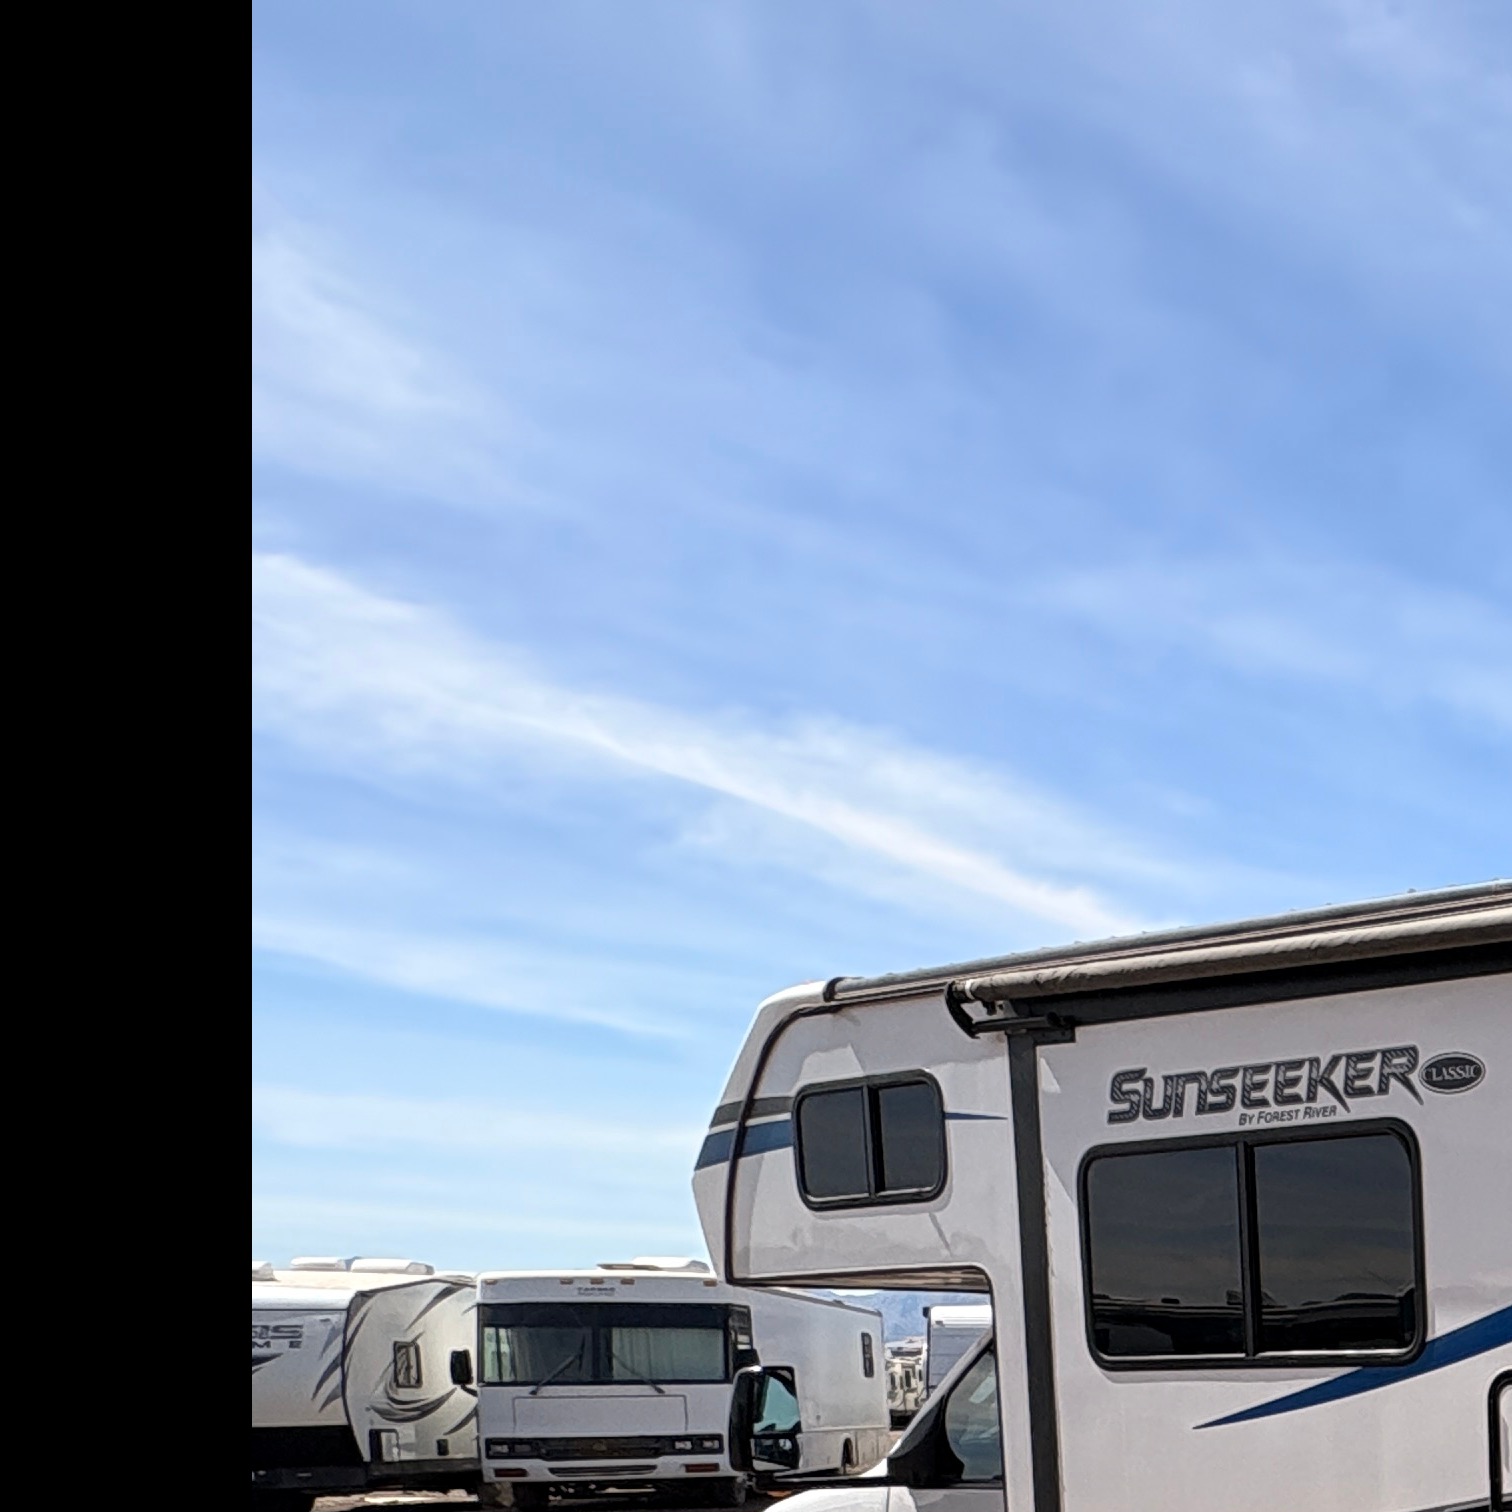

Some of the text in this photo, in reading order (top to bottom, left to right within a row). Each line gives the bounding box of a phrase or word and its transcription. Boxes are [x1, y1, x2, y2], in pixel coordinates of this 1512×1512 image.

[1423, 1064, 1480, 1081] CLASSIC
[1238, 1100, 1338, 1126] BY FOREST RIVER
